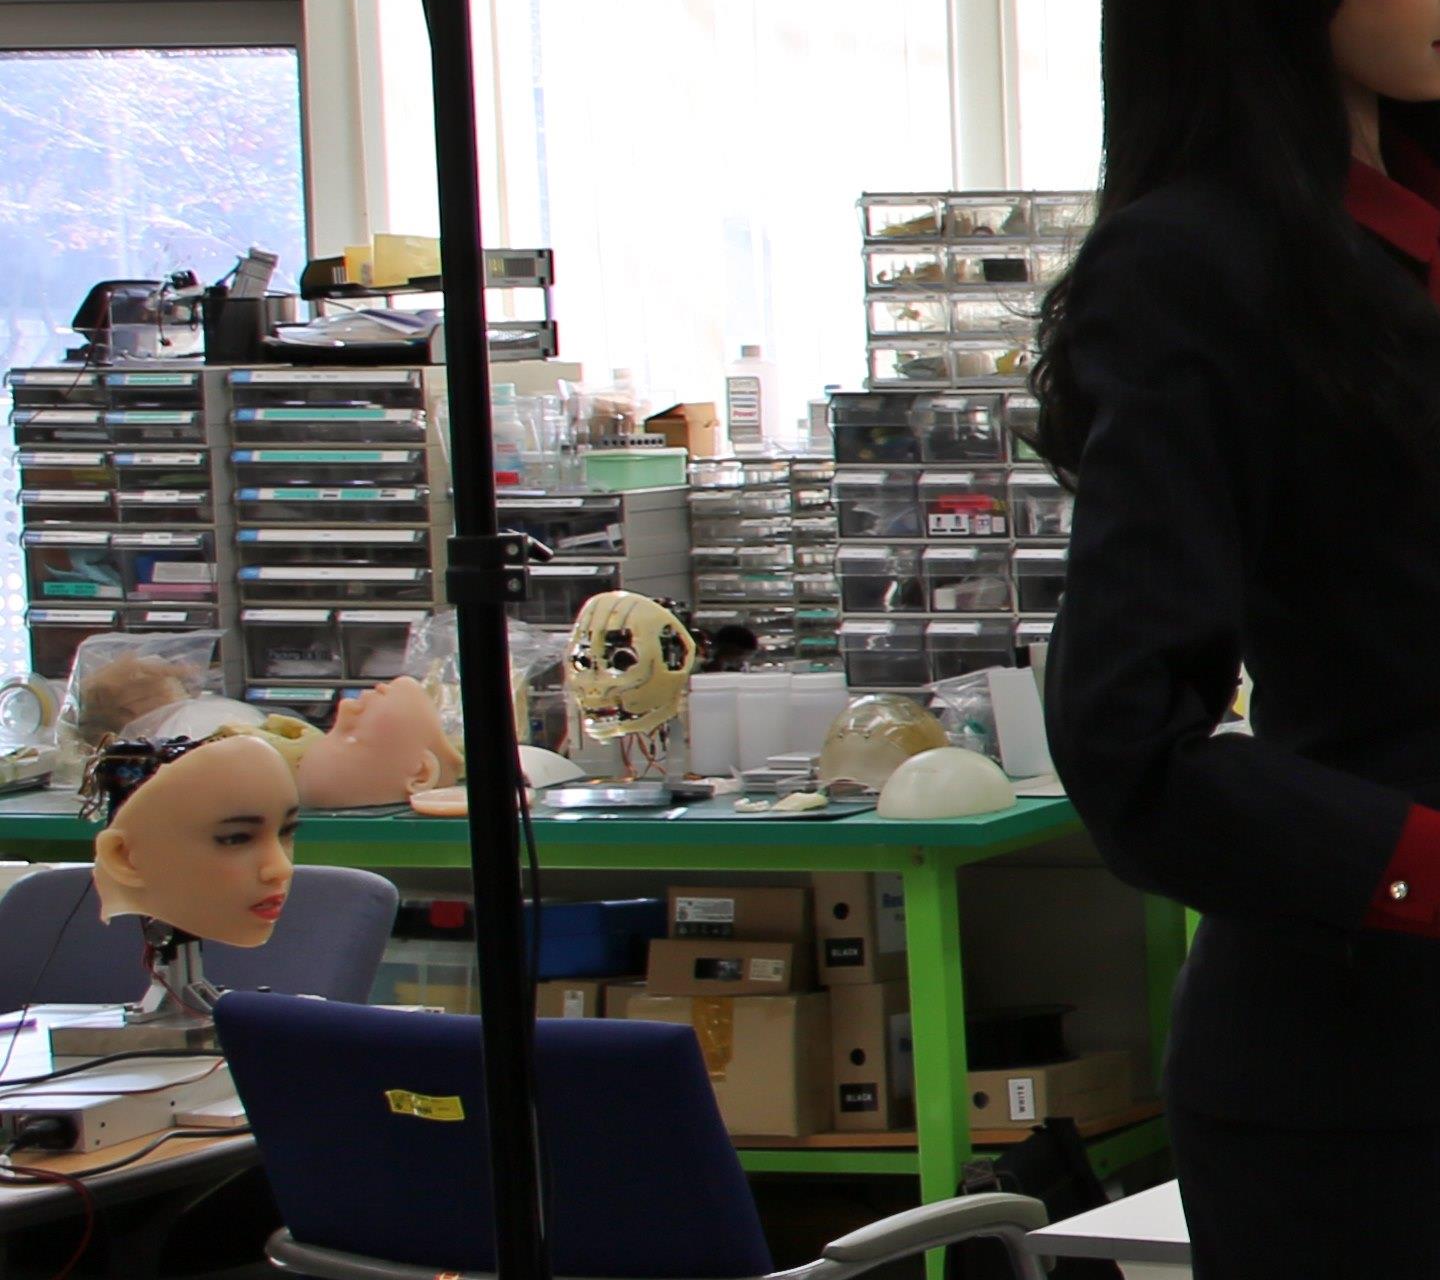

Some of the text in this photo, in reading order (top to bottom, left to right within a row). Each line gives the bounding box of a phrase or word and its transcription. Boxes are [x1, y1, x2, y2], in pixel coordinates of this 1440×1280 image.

[831, 947, 859, 958] BLACK
[846, 1093, 873, 1102] BLACK
[1016, 1084, 1026, 1114] WHITE
